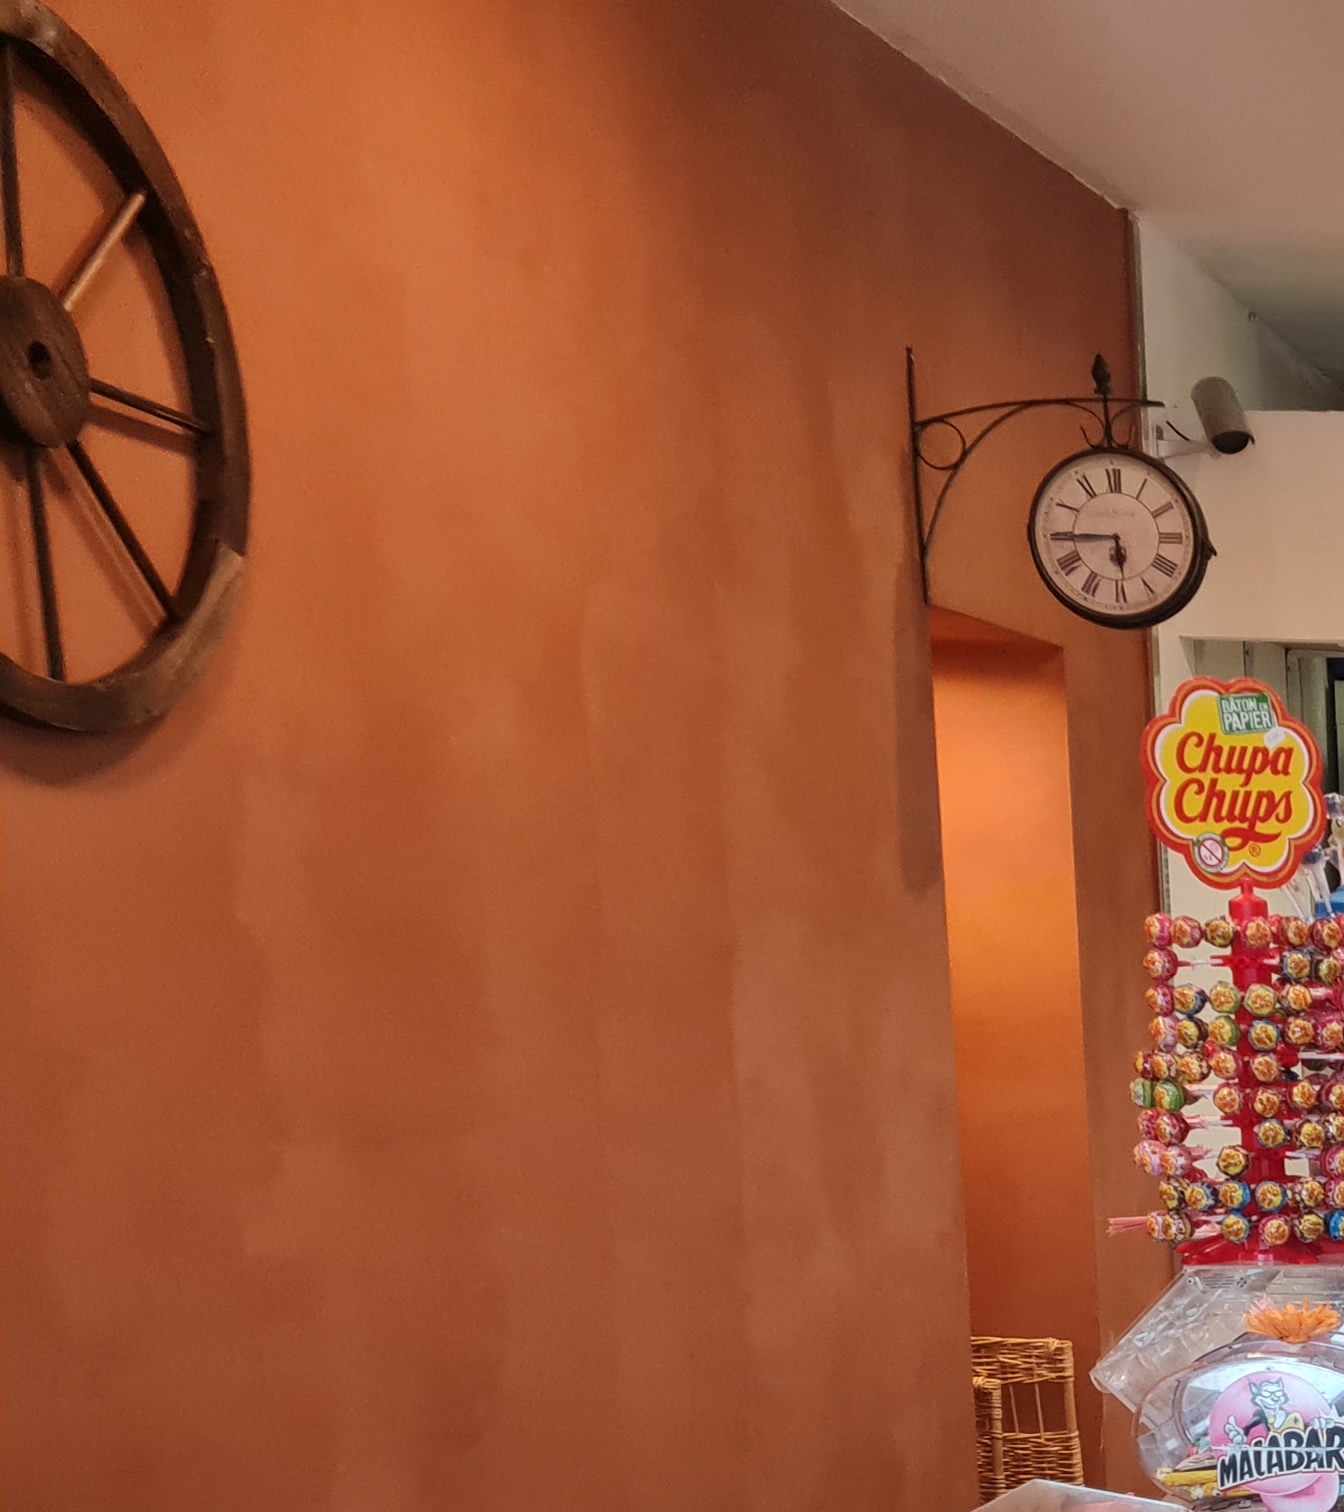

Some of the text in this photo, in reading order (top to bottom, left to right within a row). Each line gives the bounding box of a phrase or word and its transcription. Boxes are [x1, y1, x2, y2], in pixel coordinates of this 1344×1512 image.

[1222, 710, 1273, 733] PAPIER
[1175, 730, 1295, 789] Chupa
[1173, 777, 1294, 853] Chups
